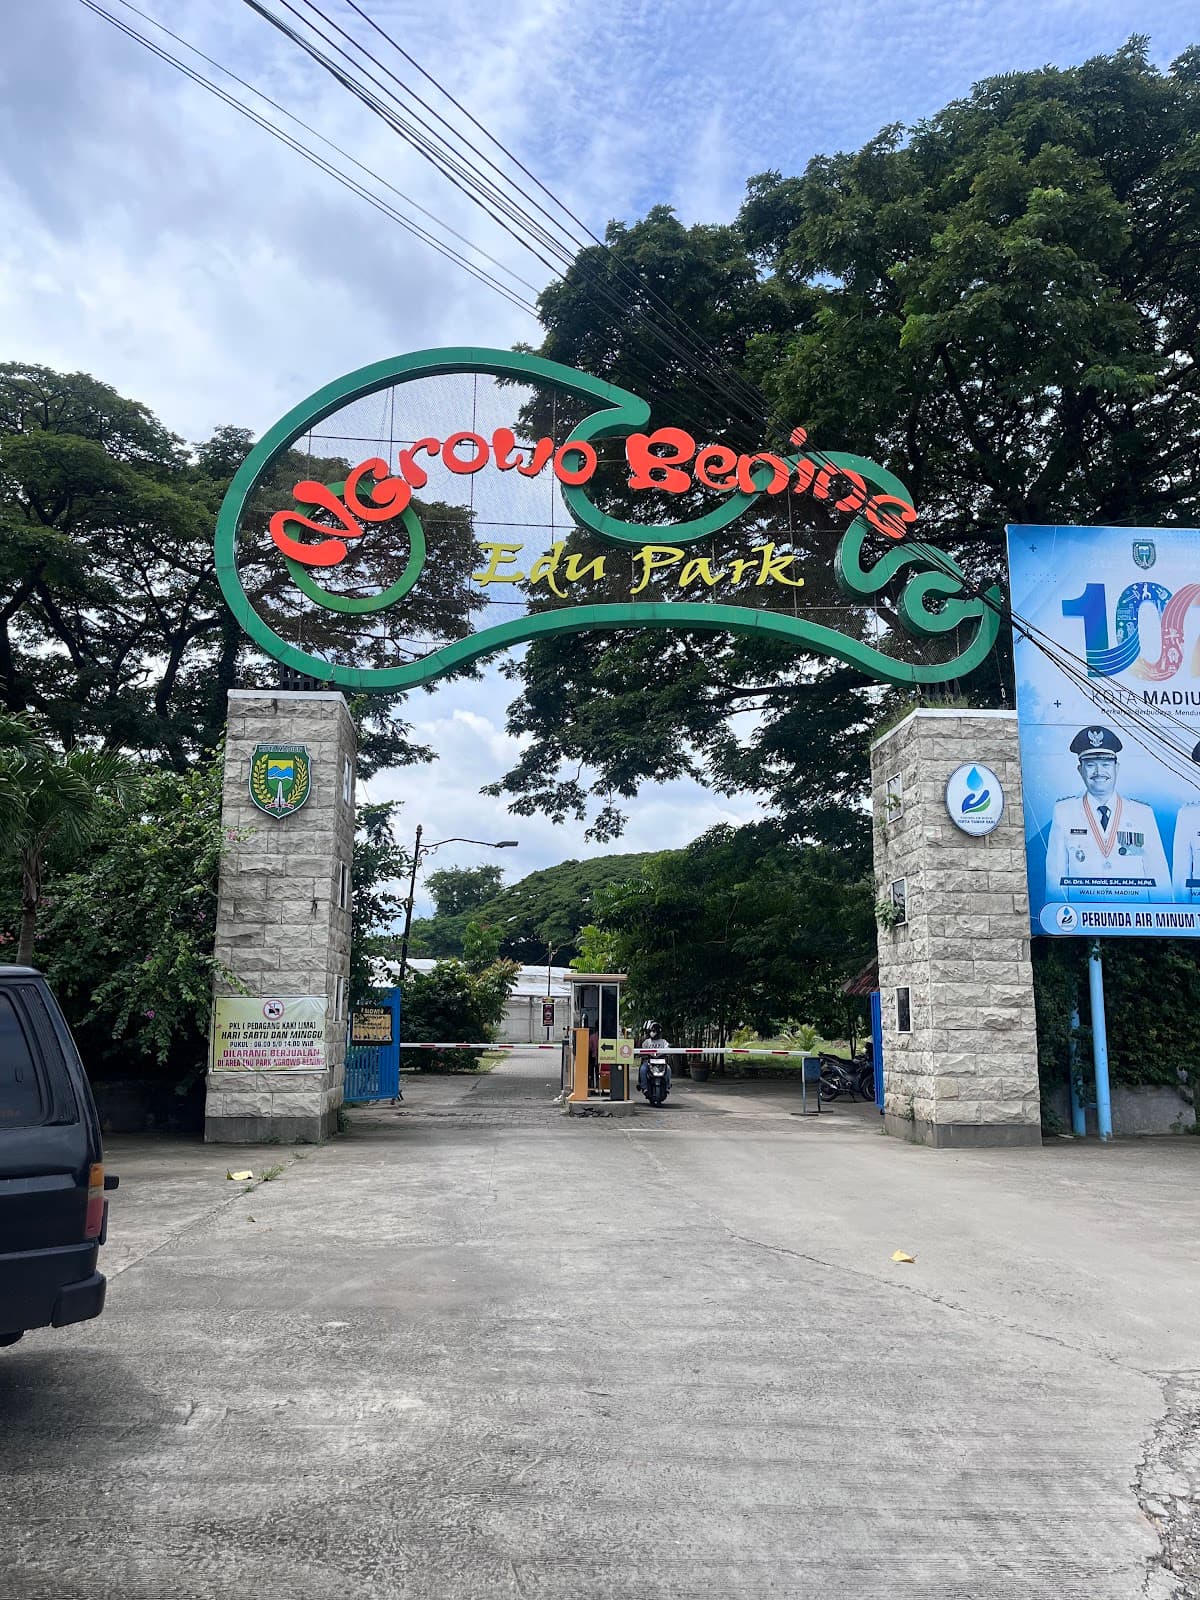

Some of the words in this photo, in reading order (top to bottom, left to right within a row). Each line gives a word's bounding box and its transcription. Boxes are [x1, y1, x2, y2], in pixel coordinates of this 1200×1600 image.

[472, 541, 606, 598] Edu
[630, 542, 805, 594] Park
[1082, 912, 1132, 927] PERUMDA
[1135, 912, 1153, 927] AIR
[1155, 913, 1196, 928] MINUM
[229, 1022, 241, 1030] PKL
[247, 1022, 281, 1030] PEDAGANG
[282, 1021, 297, 1030] KAKI
[221, 1031, 241, 1040] HARI
[243, 1031, 269, 1039] SABTU
[271, 1031, 288, 1039] DAN
[290, 1030, 323, 1039] MINGGU
[223, 1049, 267, 1058] DILARANG
[270, 1048, 320, 1057] BERJUALAN
[217, 1059, 224, 1067] DI
[225, 1059, 241, 1067] AREA
[255, 1059, 272, 1067] PARK
